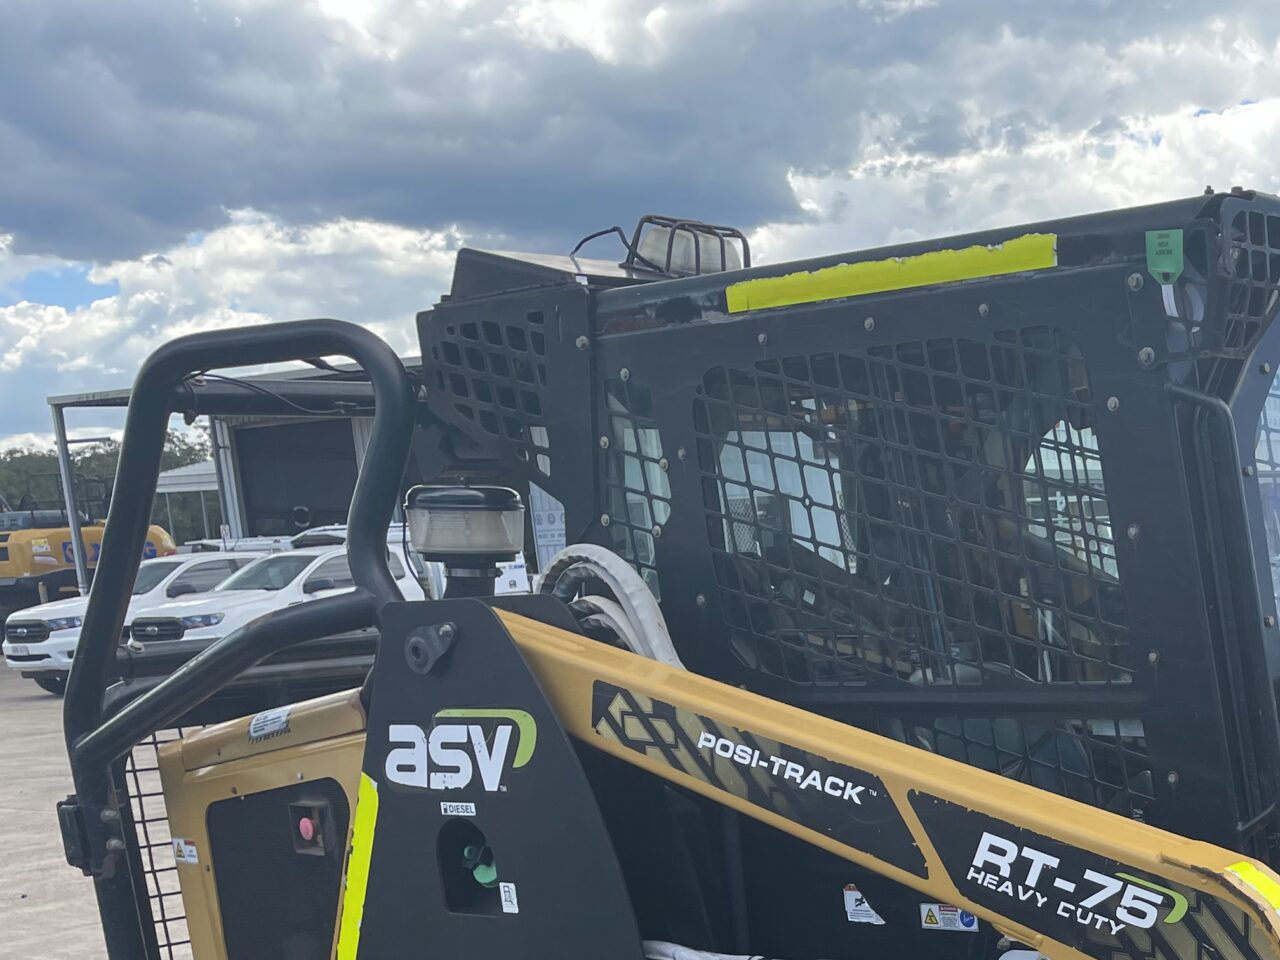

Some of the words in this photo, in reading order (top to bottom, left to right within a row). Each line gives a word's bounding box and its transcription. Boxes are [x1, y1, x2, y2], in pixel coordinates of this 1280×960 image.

[385, 724, 512, 792] asv
[697, 732, 865, 805] POSI-TRACK
[449, 804, 475, 814] DIESEL
[966, 867, 1048, 908] HEAVY
[972, 831, 1164, 929] RT-75
